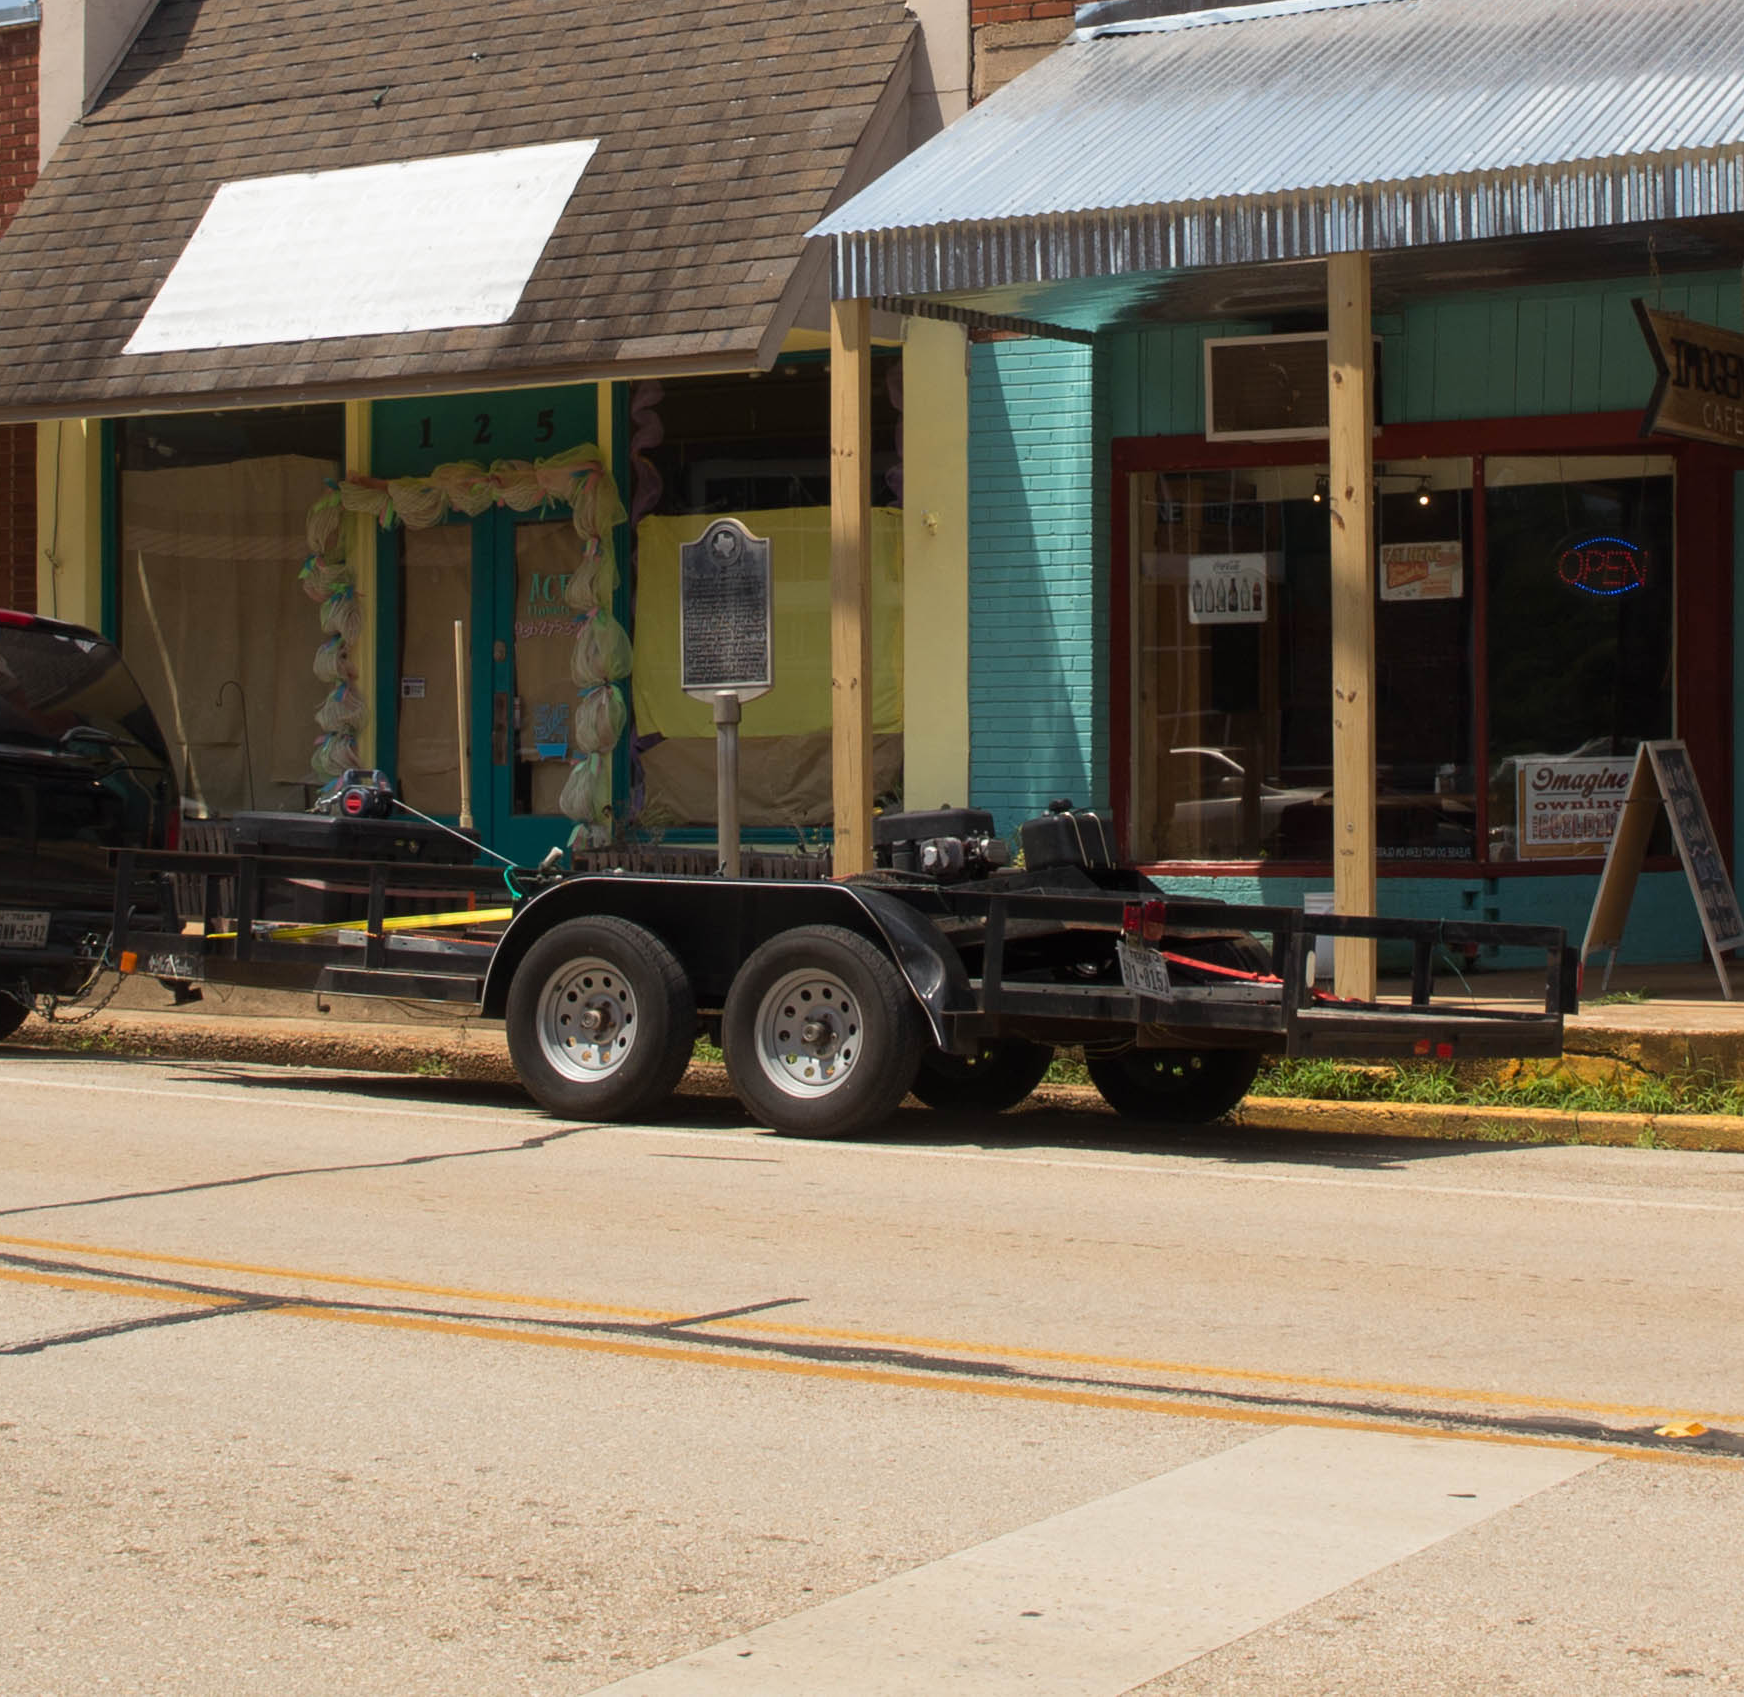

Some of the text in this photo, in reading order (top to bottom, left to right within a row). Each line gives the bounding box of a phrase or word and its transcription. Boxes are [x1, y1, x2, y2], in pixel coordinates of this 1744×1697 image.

[1556, 549, 1649, 588] OPEN
[1531, 767, 1629, 799] Imagine
[1533, 797, 1624, 812] owning
